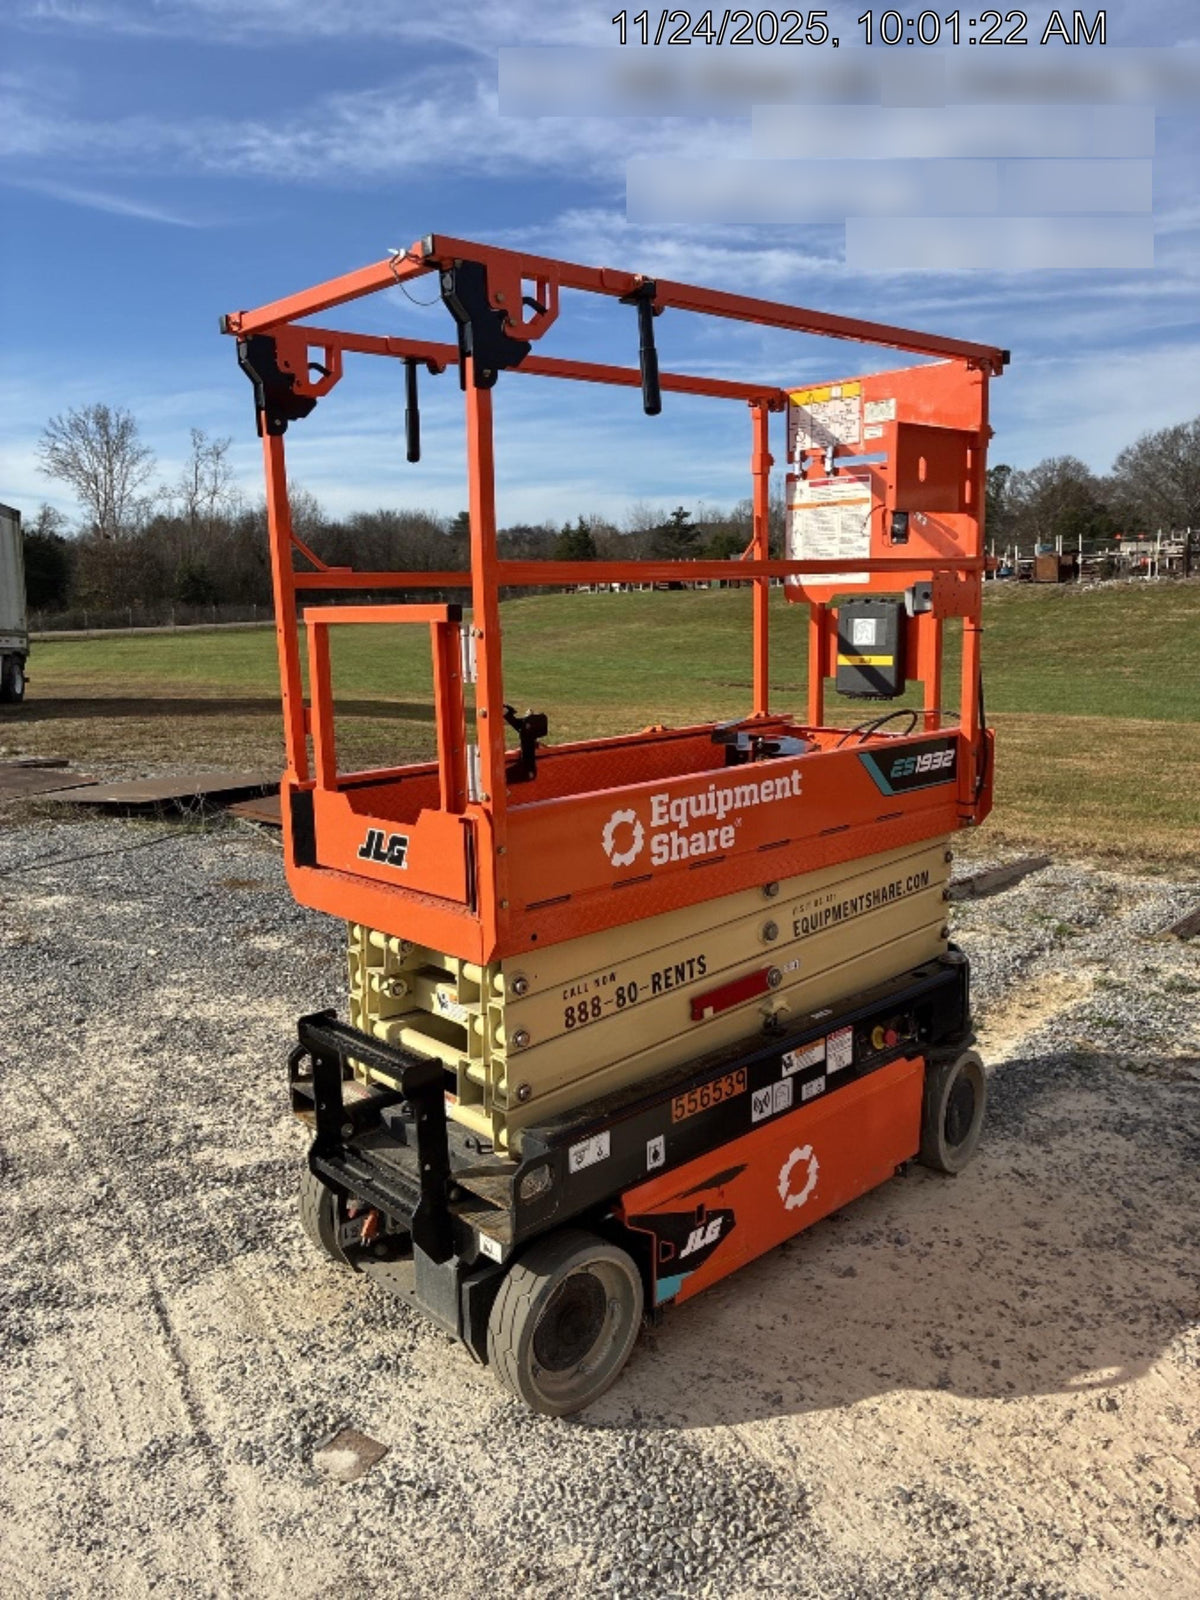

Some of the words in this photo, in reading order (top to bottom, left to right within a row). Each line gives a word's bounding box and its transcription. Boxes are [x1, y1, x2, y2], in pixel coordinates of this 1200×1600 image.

[890, 749, 956, 779] ES1932
[650, 769, 803, 829] Equipment
[357, 828, 409, 869] JLG
[650, 824, 736, 867] Share
[793, 870, 930, 938] EQUIPMENTSHARE.COM
[564, 953, 707, 1029] 888-80-RENTS
[673, 1069, 747, 1121] 556539
[679, 1215, 725, 1260] JLG
